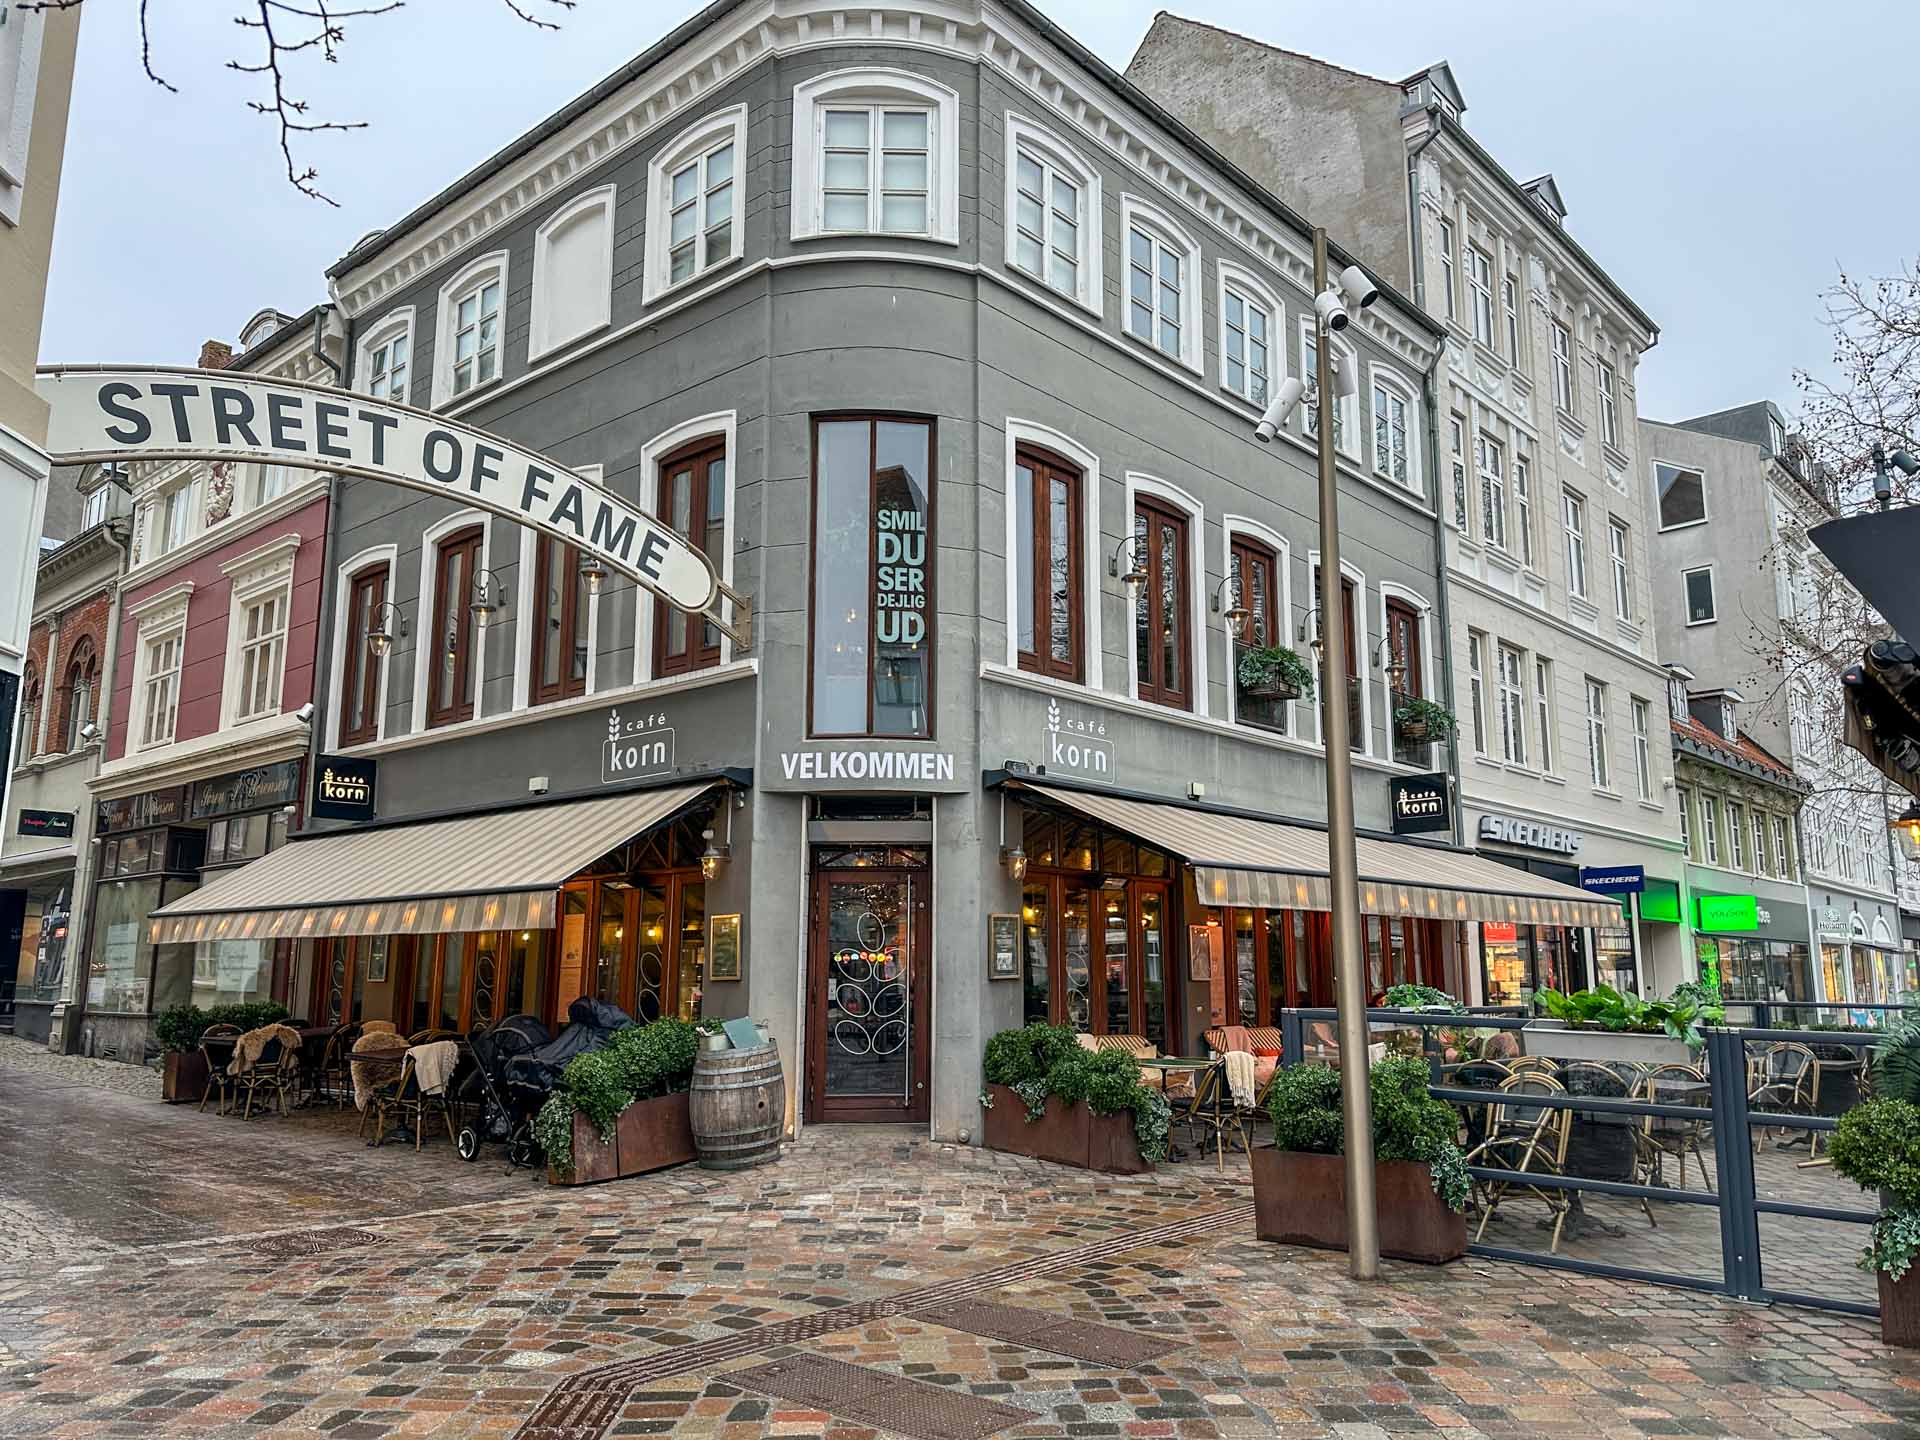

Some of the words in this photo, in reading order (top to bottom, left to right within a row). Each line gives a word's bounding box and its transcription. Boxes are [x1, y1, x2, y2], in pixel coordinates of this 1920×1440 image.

[98, 382, 398, 466] STREET
[422, 430, 504, 494] OF
[520, 463, 670, 581] FAME
[877, 509, 927, 531] SMIL
[878, 531, 926, 566] DU
[877, 566, 925, 593] SER
[877, 593, 926, 609] DEJLIG
[877, 609, 926, 643] UD
[626, 712, 666, 732] café
[1066, 719, 1106, 736] café
[610, 741, 666, 772] korn
[780, 751, 954, 781] VELKOMMEN
[1051, 732, 1107, 773] korn
[325, 783, 365, 800] korn
[1402, 800, 1438, 815] korn
[1481, 815, 1584, 854] SKECHERS
[1584, 875, 1640, 886] SKECHERS
